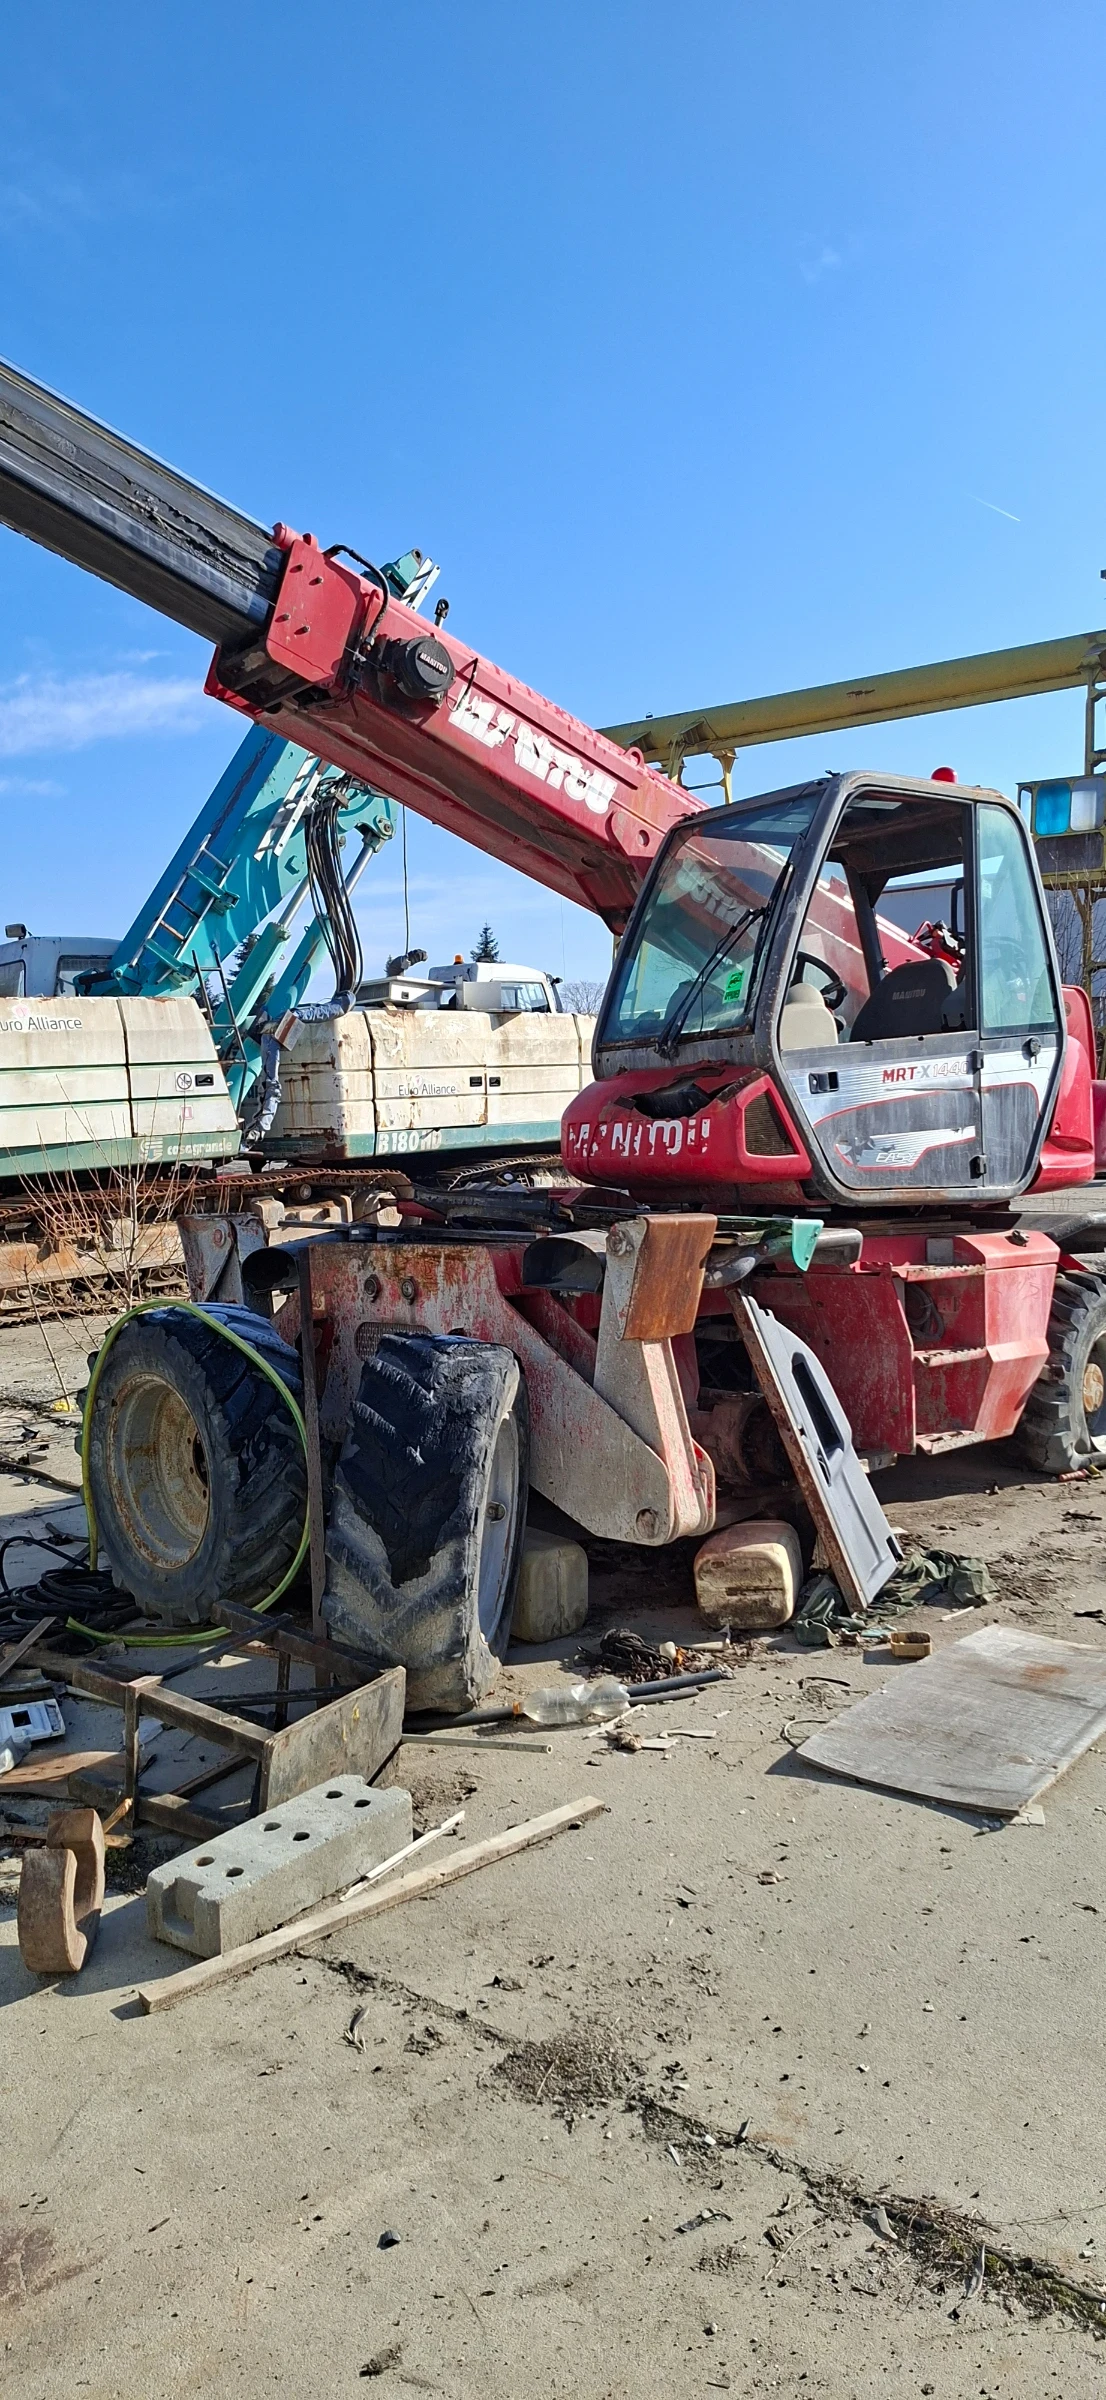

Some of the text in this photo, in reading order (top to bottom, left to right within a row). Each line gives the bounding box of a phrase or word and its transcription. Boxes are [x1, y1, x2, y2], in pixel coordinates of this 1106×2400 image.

[420, 652, 448, 674] MANITOU
[892, 988, 926, 1001] MANITOU
[0, 1016, 83, 1032] uro Alliance
[421, 1083, 456, 1095] Alliance
